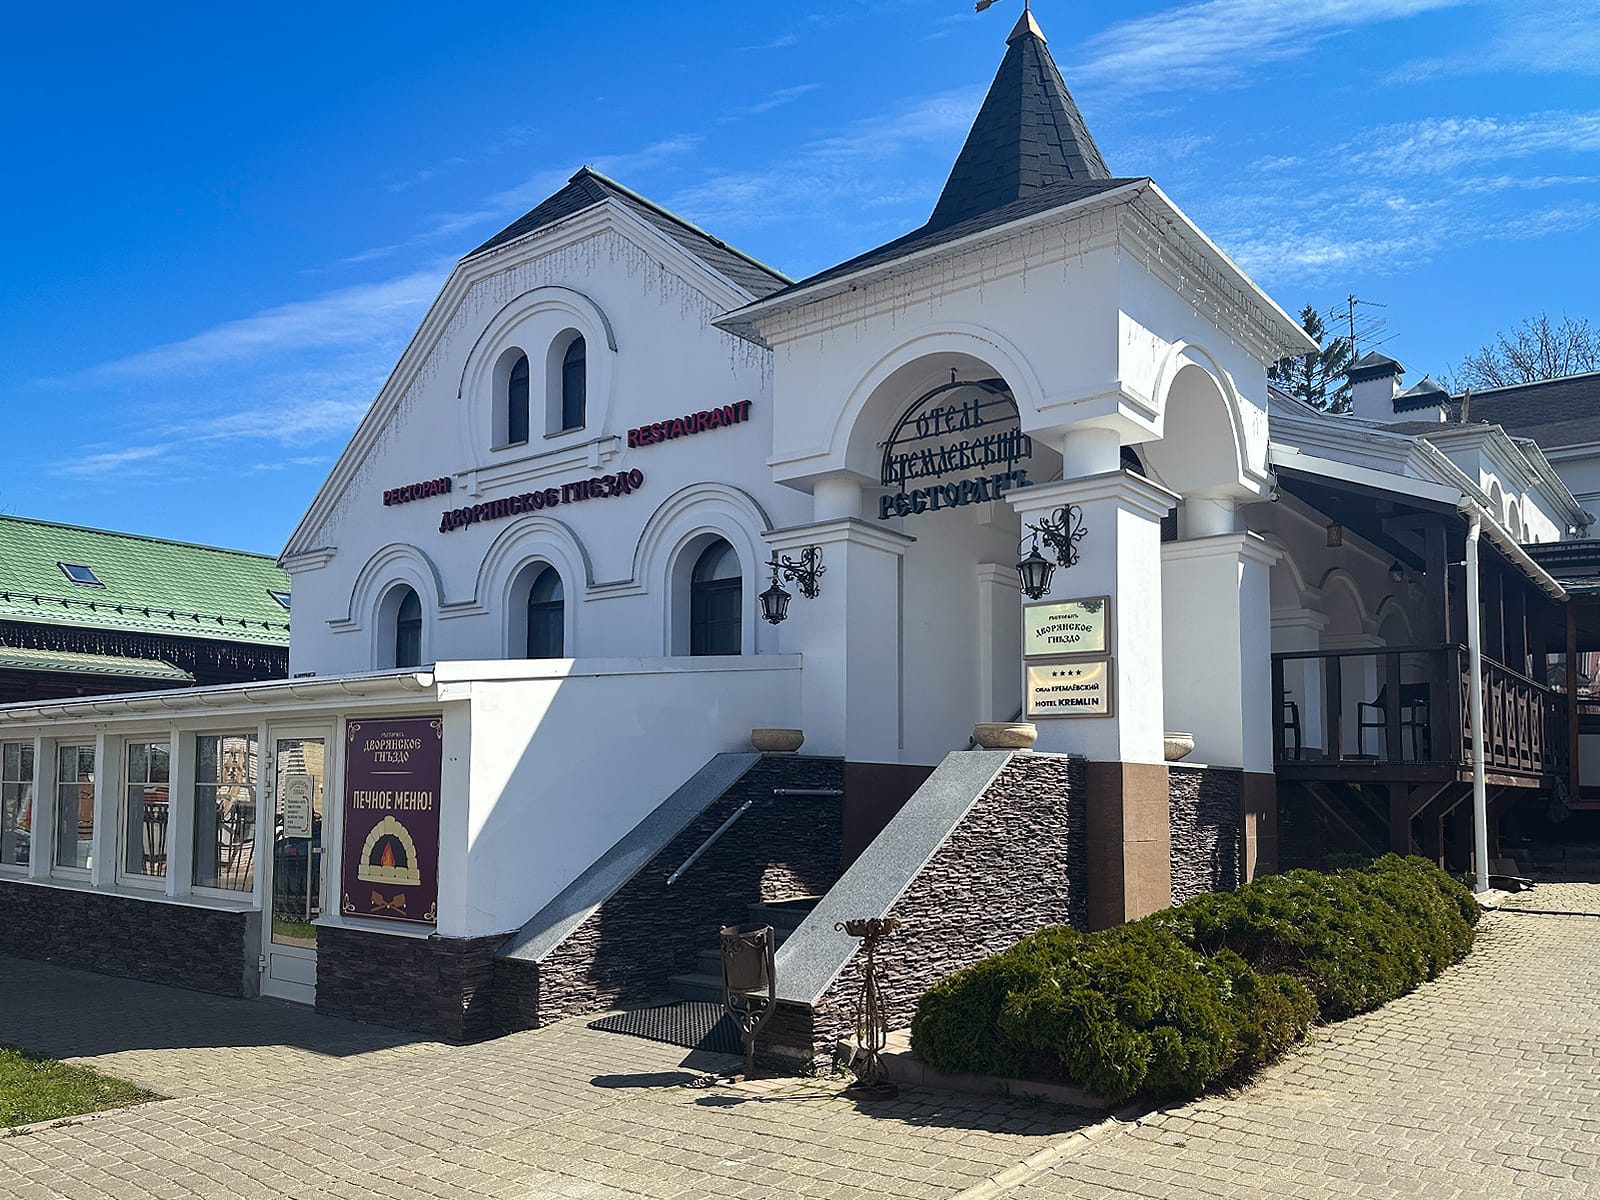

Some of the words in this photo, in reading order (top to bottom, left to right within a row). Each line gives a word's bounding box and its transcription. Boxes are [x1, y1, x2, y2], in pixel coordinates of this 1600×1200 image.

[627, 400, 752, 448] RESTAURANT
[915, 398, 985, 440] ОТЕЛЬ
[382, 476, 452, 507] РЕСТОРАН
[438, 487, 561, 534] ДВОРЯНСКОЕ
[560, 467, 644, 505] ГНЕЗДО
[1035, 622, 1093, 638] ДВОРЯНСКОЕ
[1058, 697, 1099, 706] KREMLIN
[363, 738, 422, 752] ДВОРЯНСКОЕ
[353, 790, 392, 810] ПЕЧНОЕ
[394, 791, 433, 811] МЕНЮ!
